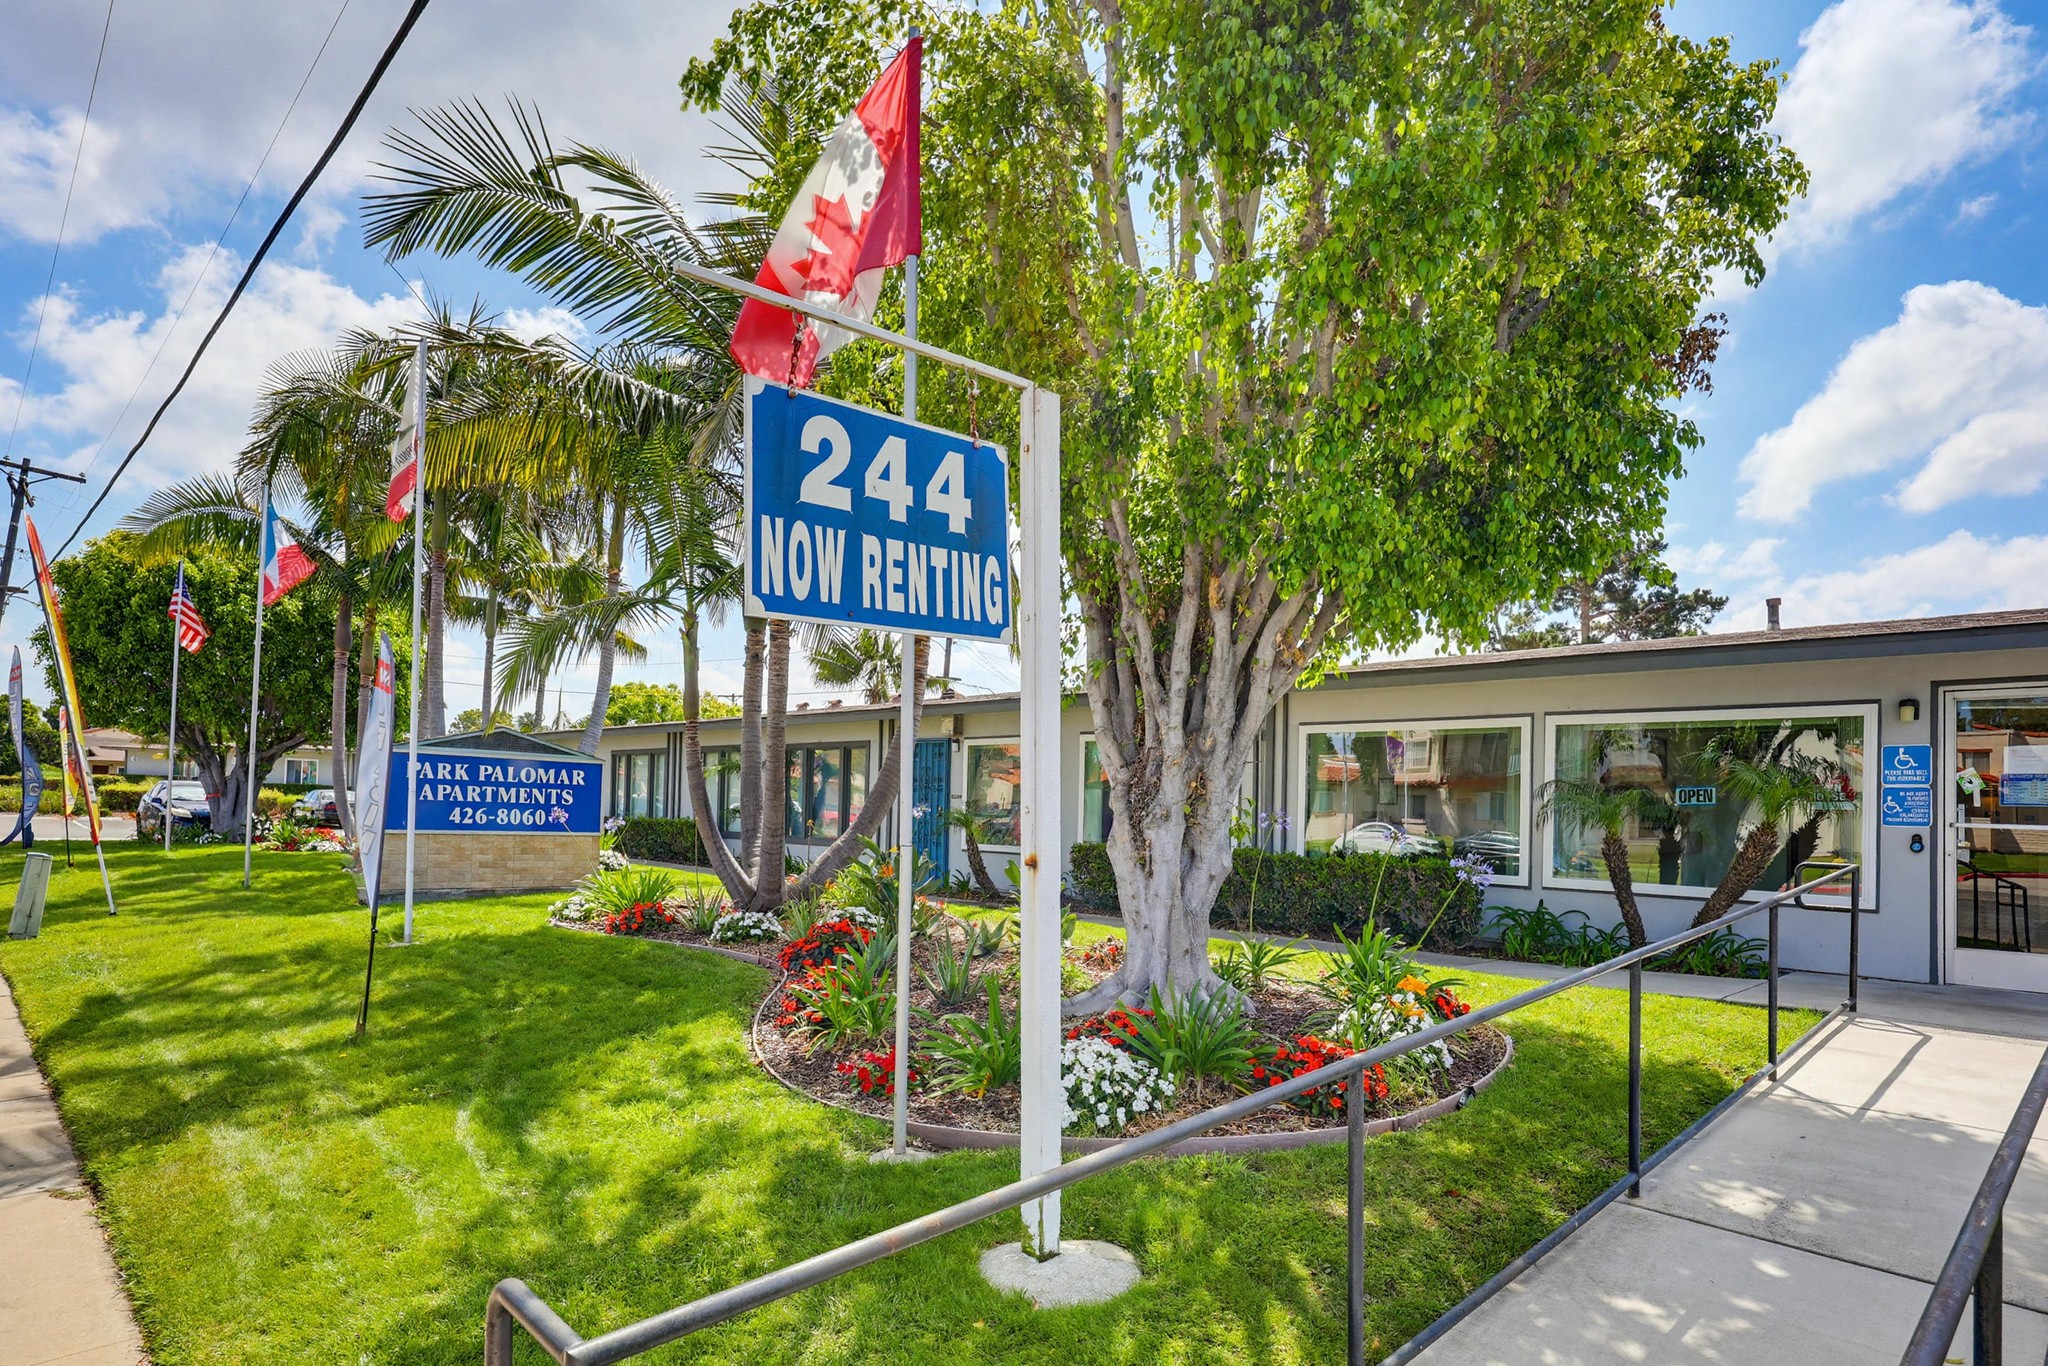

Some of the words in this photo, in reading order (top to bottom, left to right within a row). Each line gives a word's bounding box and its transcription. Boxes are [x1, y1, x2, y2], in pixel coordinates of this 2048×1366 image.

[797, 415, 973, 537] 244
[761, 514, 846, 604] NOW
[861, 531, 1003, 624] RENTING
[478, 765, 586, 786] PALOMAR
[419, 784, 574, 805] APARTMENTS
[1678, 788, 1713, 804] OPEN
[449, 807, 546, 826] 426-8060
